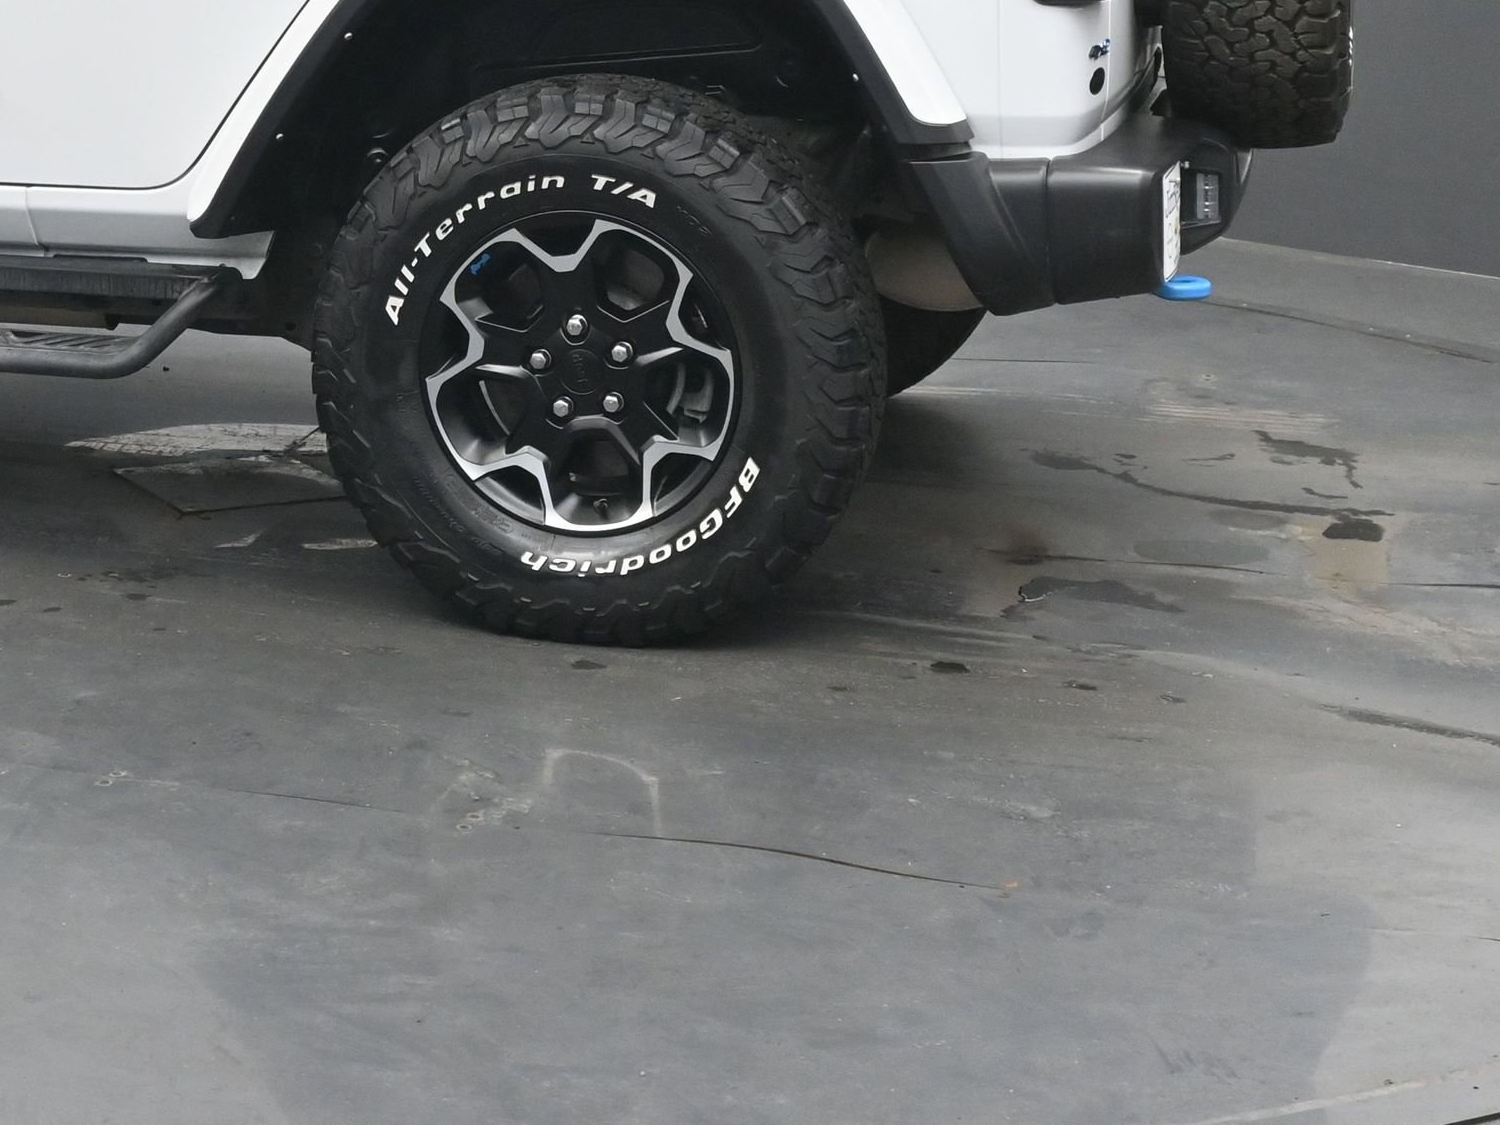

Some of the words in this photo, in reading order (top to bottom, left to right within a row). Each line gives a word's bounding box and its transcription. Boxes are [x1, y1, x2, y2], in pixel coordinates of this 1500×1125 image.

[385, 174, 565, 325] All-Terrain
[591, 174, 657, 209] T/A
[520, 457, 761, 577] BFGoodrich
